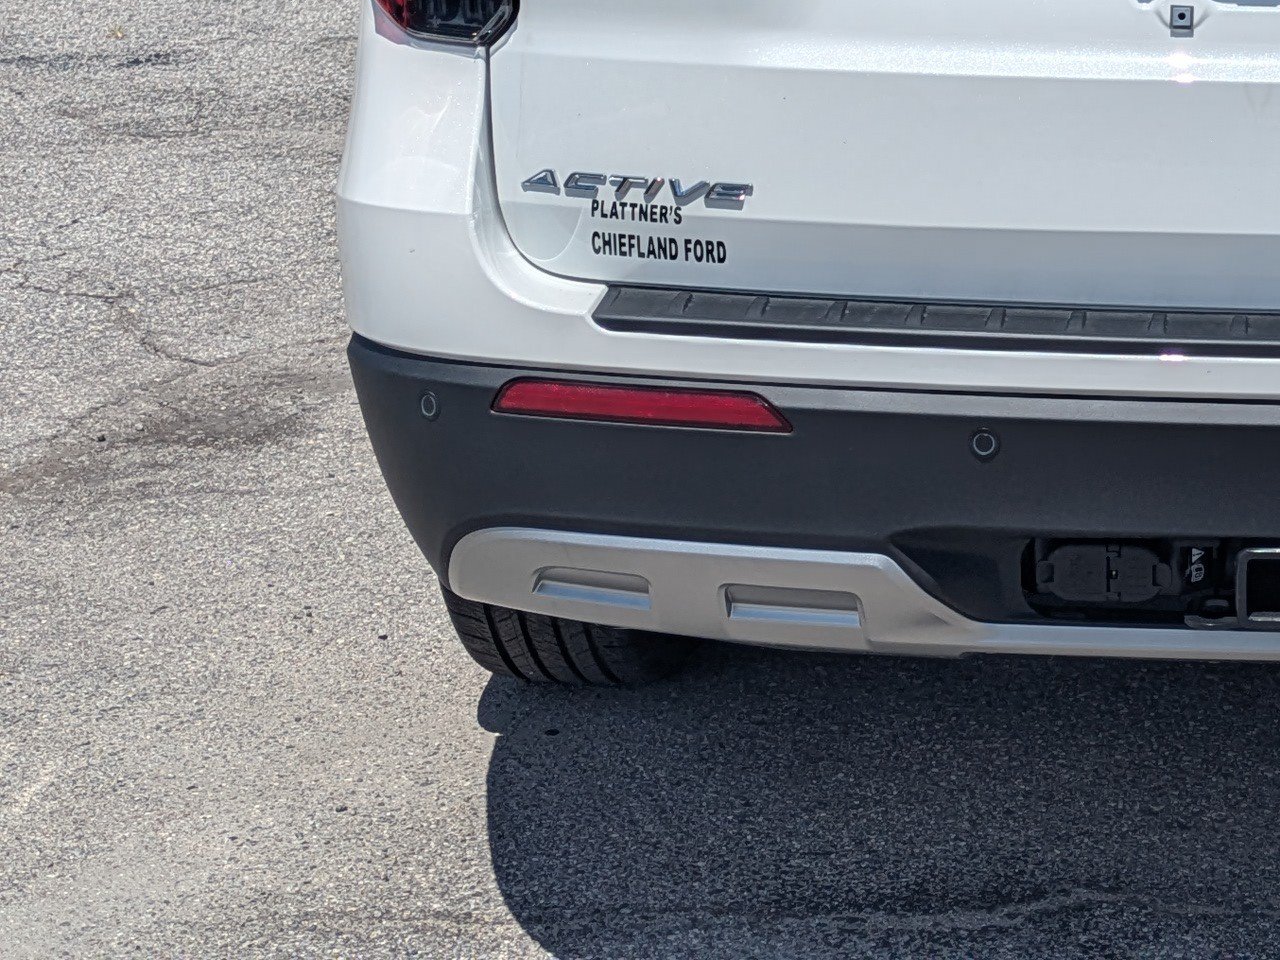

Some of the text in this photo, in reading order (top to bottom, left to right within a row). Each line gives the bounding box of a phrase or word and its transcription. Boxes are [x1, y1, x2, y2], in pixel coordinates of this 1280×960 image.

[521, 168, 753, 210] ACTIVE
[591, 199, 683, 225] PLATTNER'S
[591, 230, 727, 264] CHIEFLAND FORD
